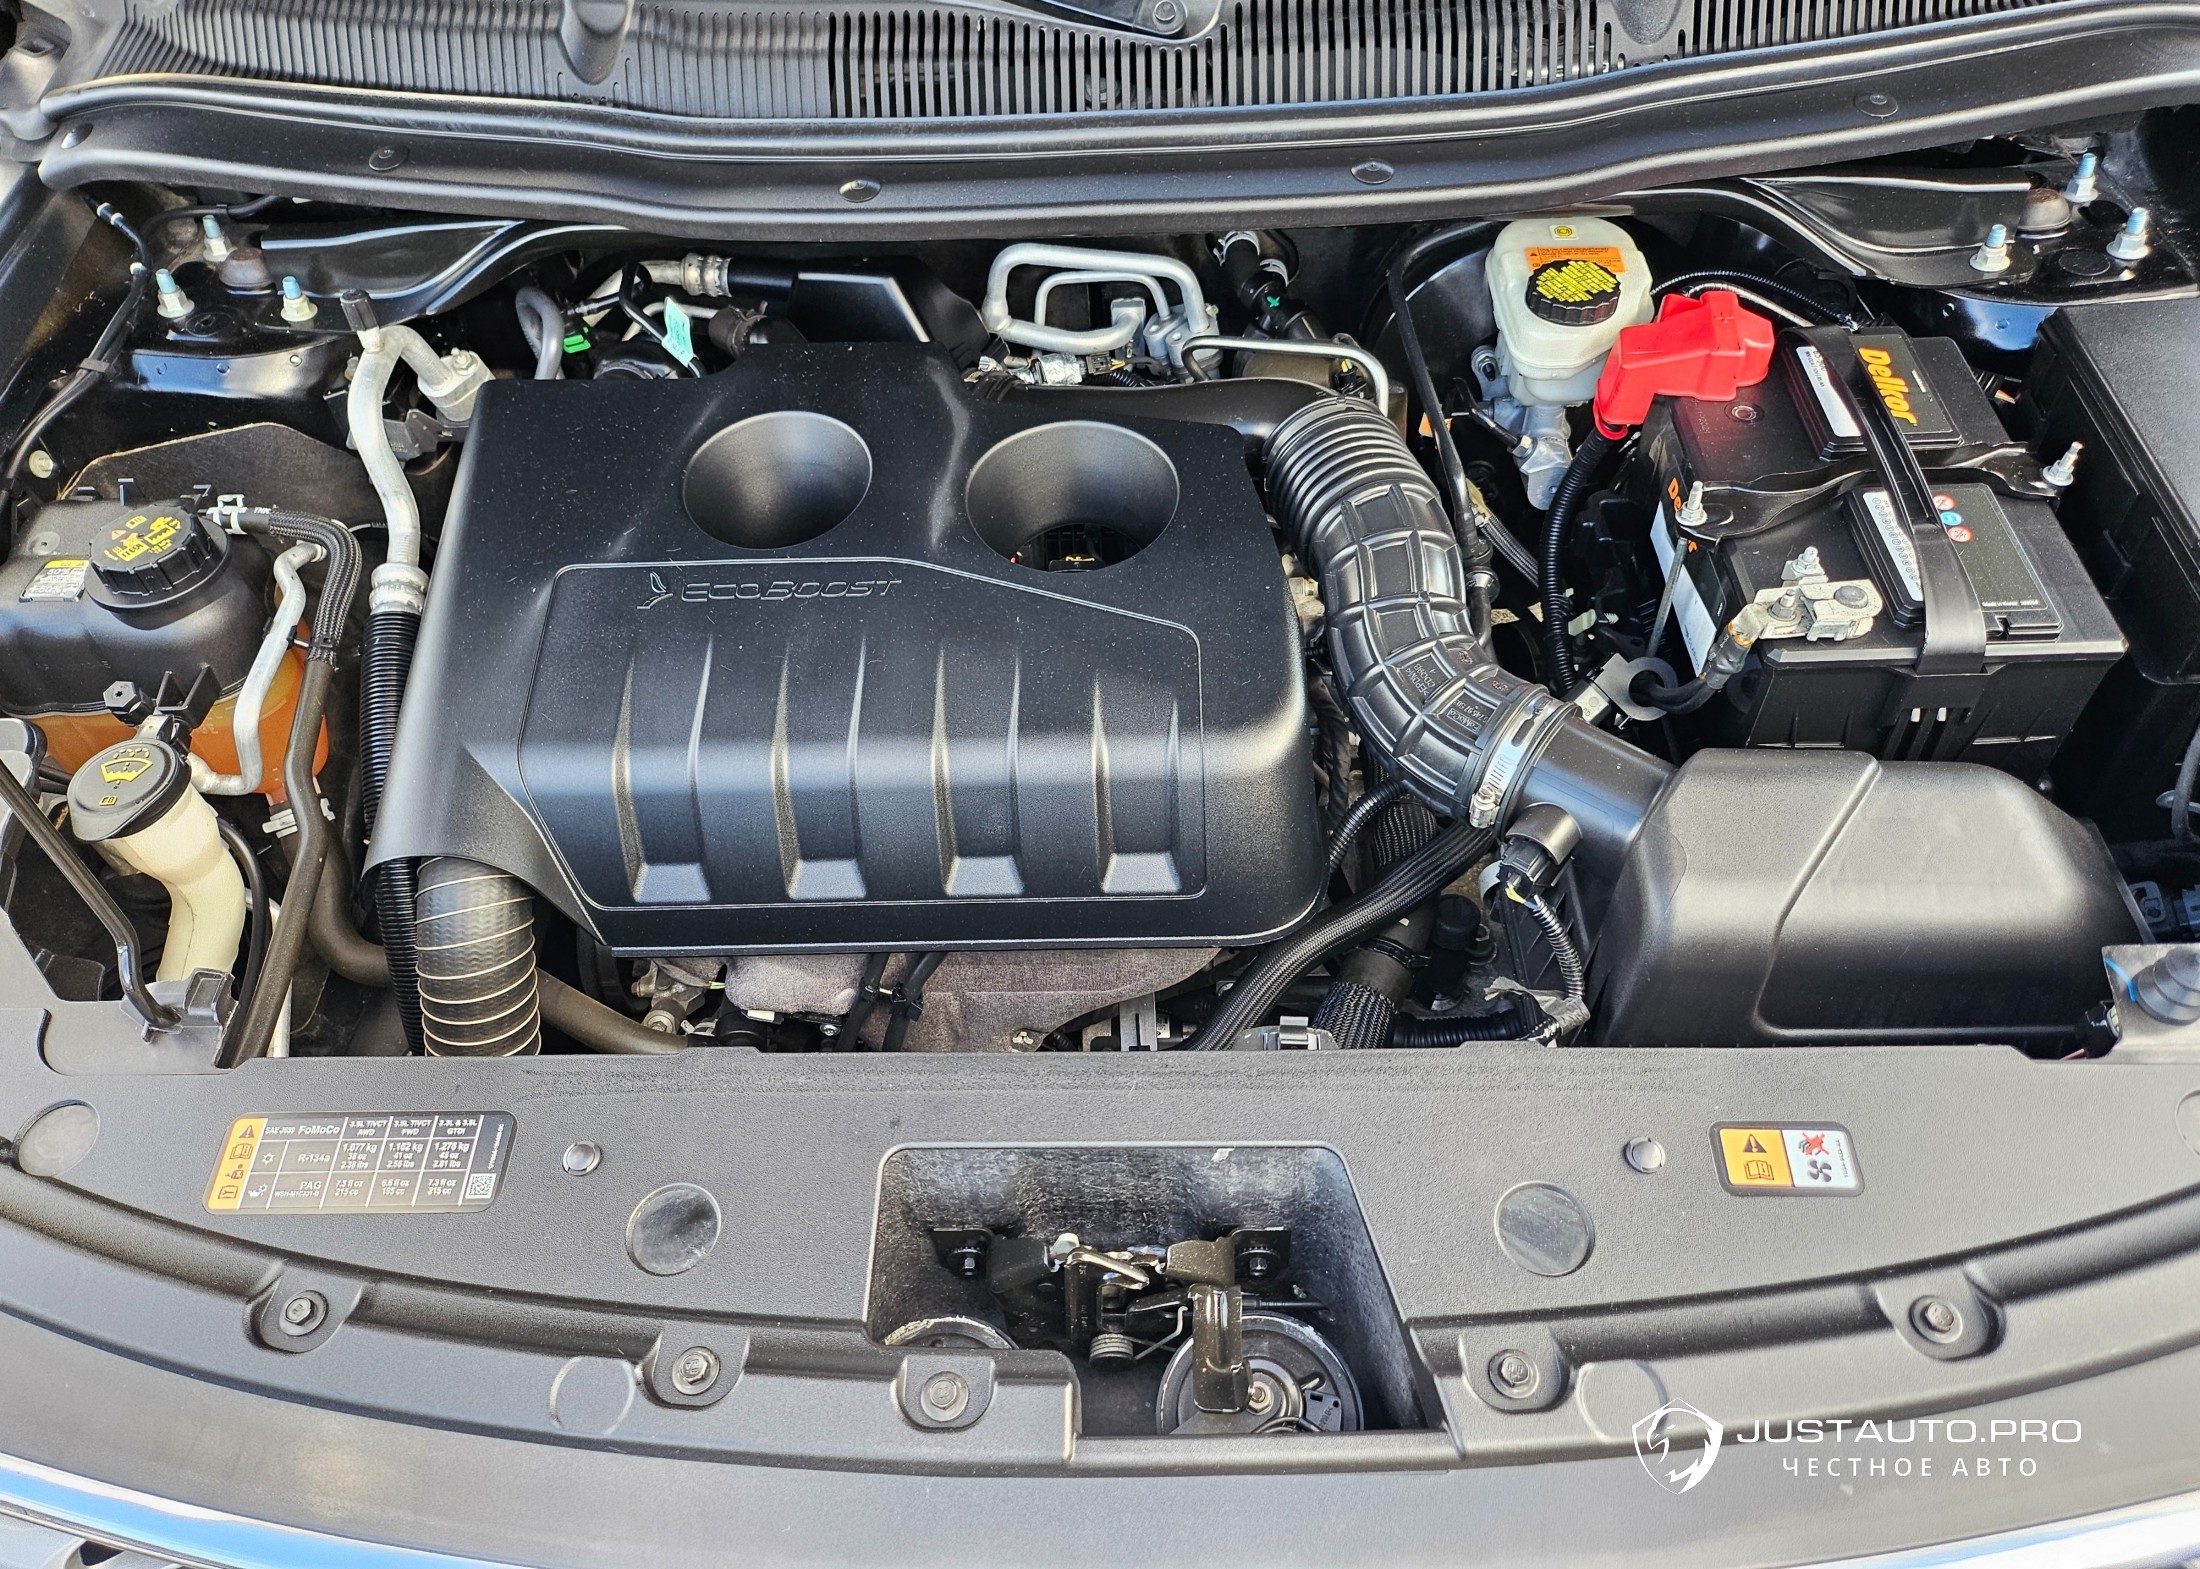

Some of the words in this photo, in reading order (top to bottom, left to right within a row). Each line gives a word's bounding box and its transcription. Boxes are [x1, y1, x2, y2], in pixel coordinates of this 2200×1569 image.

[1858, 347, 1917, 424] Delkor
[265, 1126, 279, 1134] SAE
[298, 1125, 341, 1135] FoMoCo
[357, 1128, 375, 1136] AWD
[401, 1128, 419, 1136] FWD
[343, 1143, 366, 1152] 1.077
[366, 1143, 378, 1153] kg
[412, 1142, 424, 1152] kg
[458, 1142, 470, 1152] kg
[297, 1153, 331, 1162] R-134a
[357, 1160, 368, 1168] lbs
[403, 1160, 415, 1168] lbs
[449, 1160, 461, 1168] lbs
[300, 1180, 322, 1190] PAG
[335, 1179, 347, 1187] 7.3
[335, 1188, 348, 1196] 215
[382, 1187, 395, 1195] 195
[427, 1187, 441, 1195] 215
